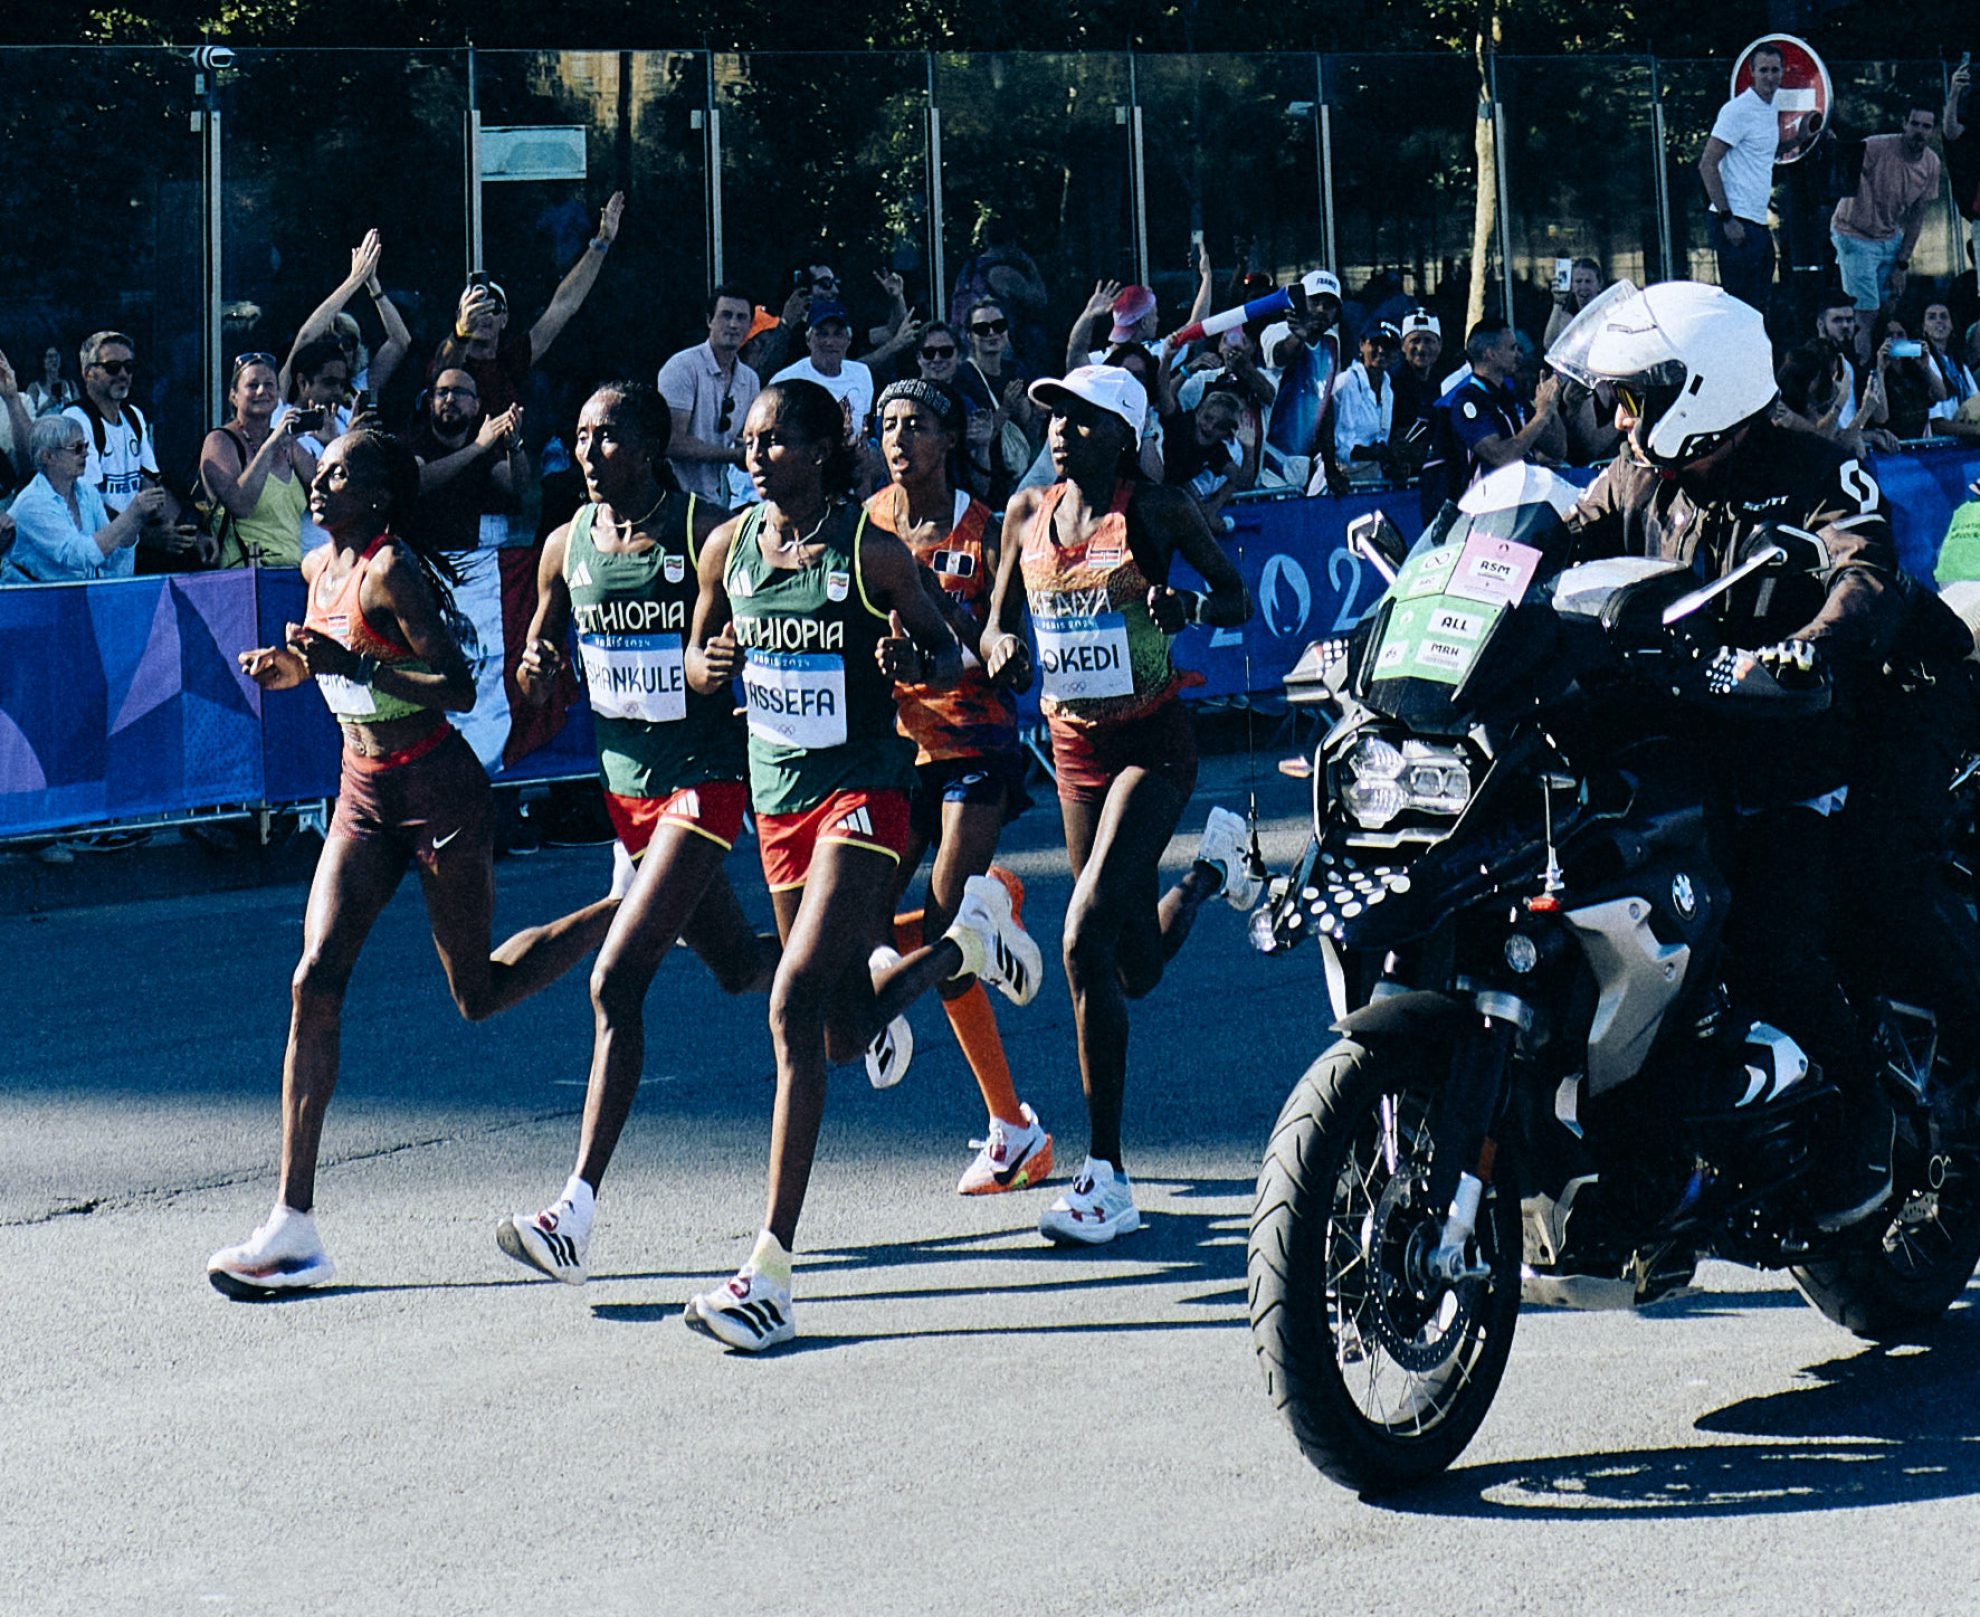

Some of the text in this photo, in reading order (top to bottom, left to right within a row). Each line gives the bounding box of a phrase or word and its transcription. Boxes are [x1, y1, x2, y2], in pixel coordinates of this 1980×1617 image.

[1480, 560, 1511, 575] RSM
[573, 600, 685, 634] ETHIOPIA
[1441, 616, 1468, 631] ALL
[586, 659, 684, 695] SHANKULE
[748, 680, 836, 717] ASSEFA
